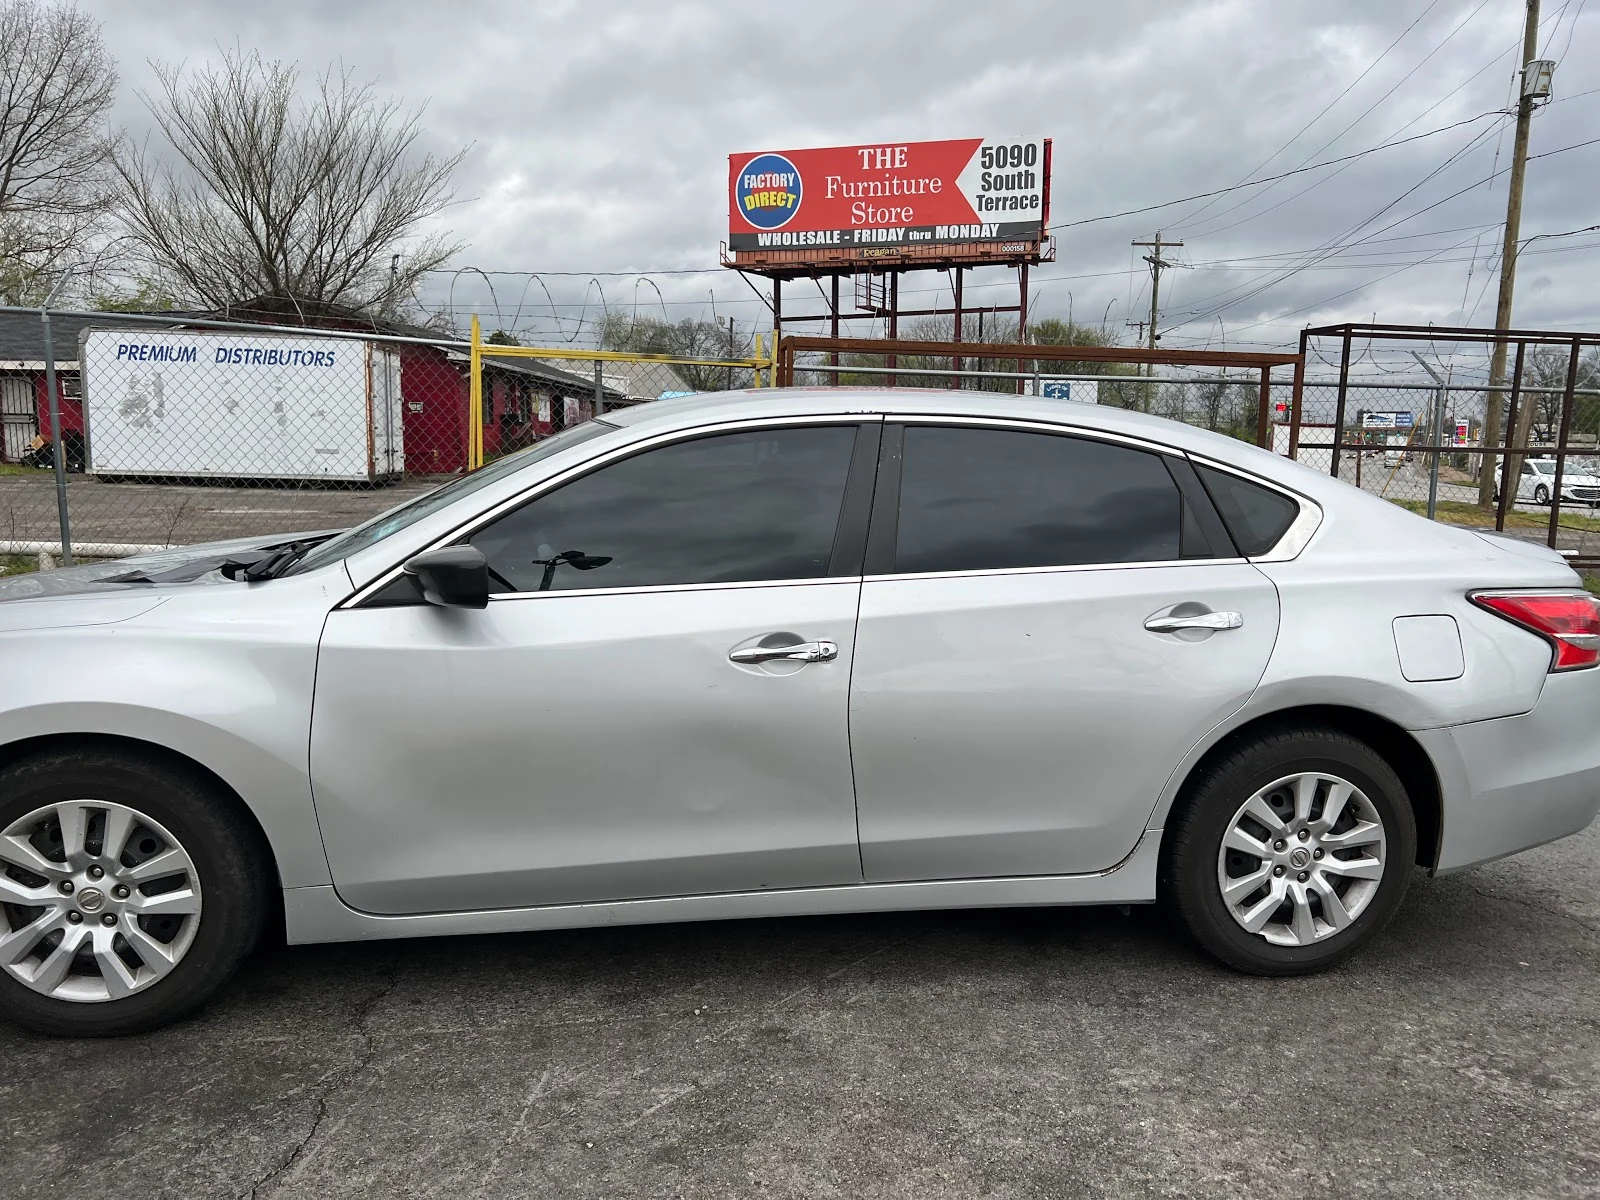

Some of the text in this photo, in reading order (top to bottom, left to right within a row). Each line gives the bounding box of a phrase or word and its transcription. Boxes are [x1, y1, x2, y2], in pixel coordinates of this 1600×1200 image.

[858, 146, 908, 170] THE
[981, 143, 1037, 170] 5090
[744, 172, 795, 189] FACTORY
[824, 173, 942, 199] Furniture
[981, 169, 1036, 192] South
[744, 191, 797, 211] DIRECT
[976, 194, 1040, 212] Terrace
[851, 201, 914, 225] Store
[757, 230, 840, 246] WHOLESALE
[854, 227, 905, 243] FRIDAY
[909, 231, 931, 240] thru
[935, 223, 1000, 239] MONDAY
[863, 248, 896, 257] Reagan
[117, 345, 335, 367] PREMIUM DISTRIBUTORS
